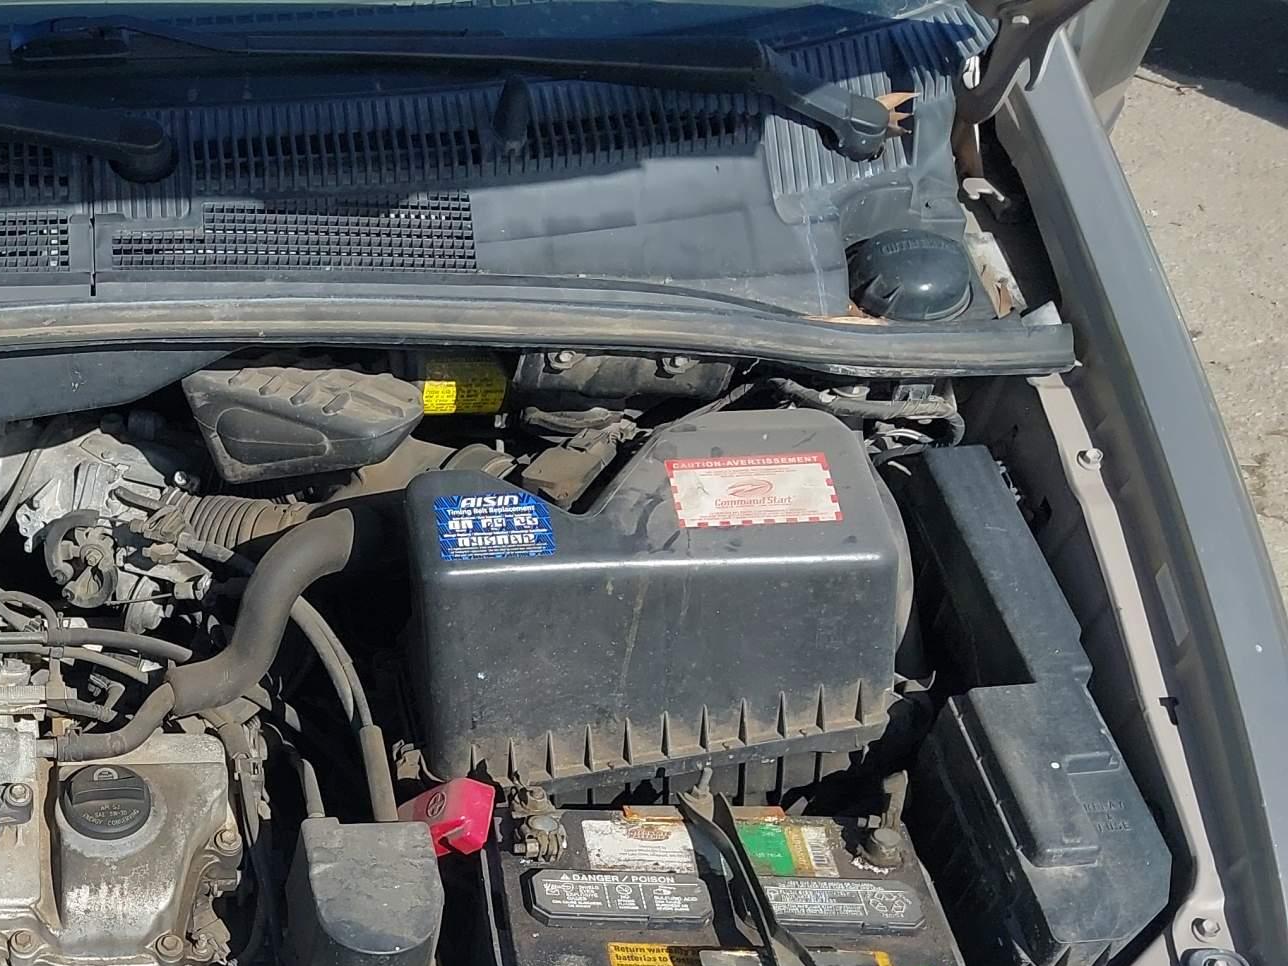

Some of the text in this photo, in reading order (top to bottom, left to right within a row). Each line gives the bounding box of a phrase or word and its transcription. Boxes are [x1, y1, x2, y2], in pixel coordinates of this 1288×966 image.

[461, 495, 519, 508] AISIN
[714, 495, 792, 507] Command Start
[447, 505, 535, 516] Timing Belt Replacement
[572, 874, 619, 882] DANGER
[631, 875, 675, 884] POISON
[614, 945, 646, 953] Return
[615, 953, 657, 962] batteries
